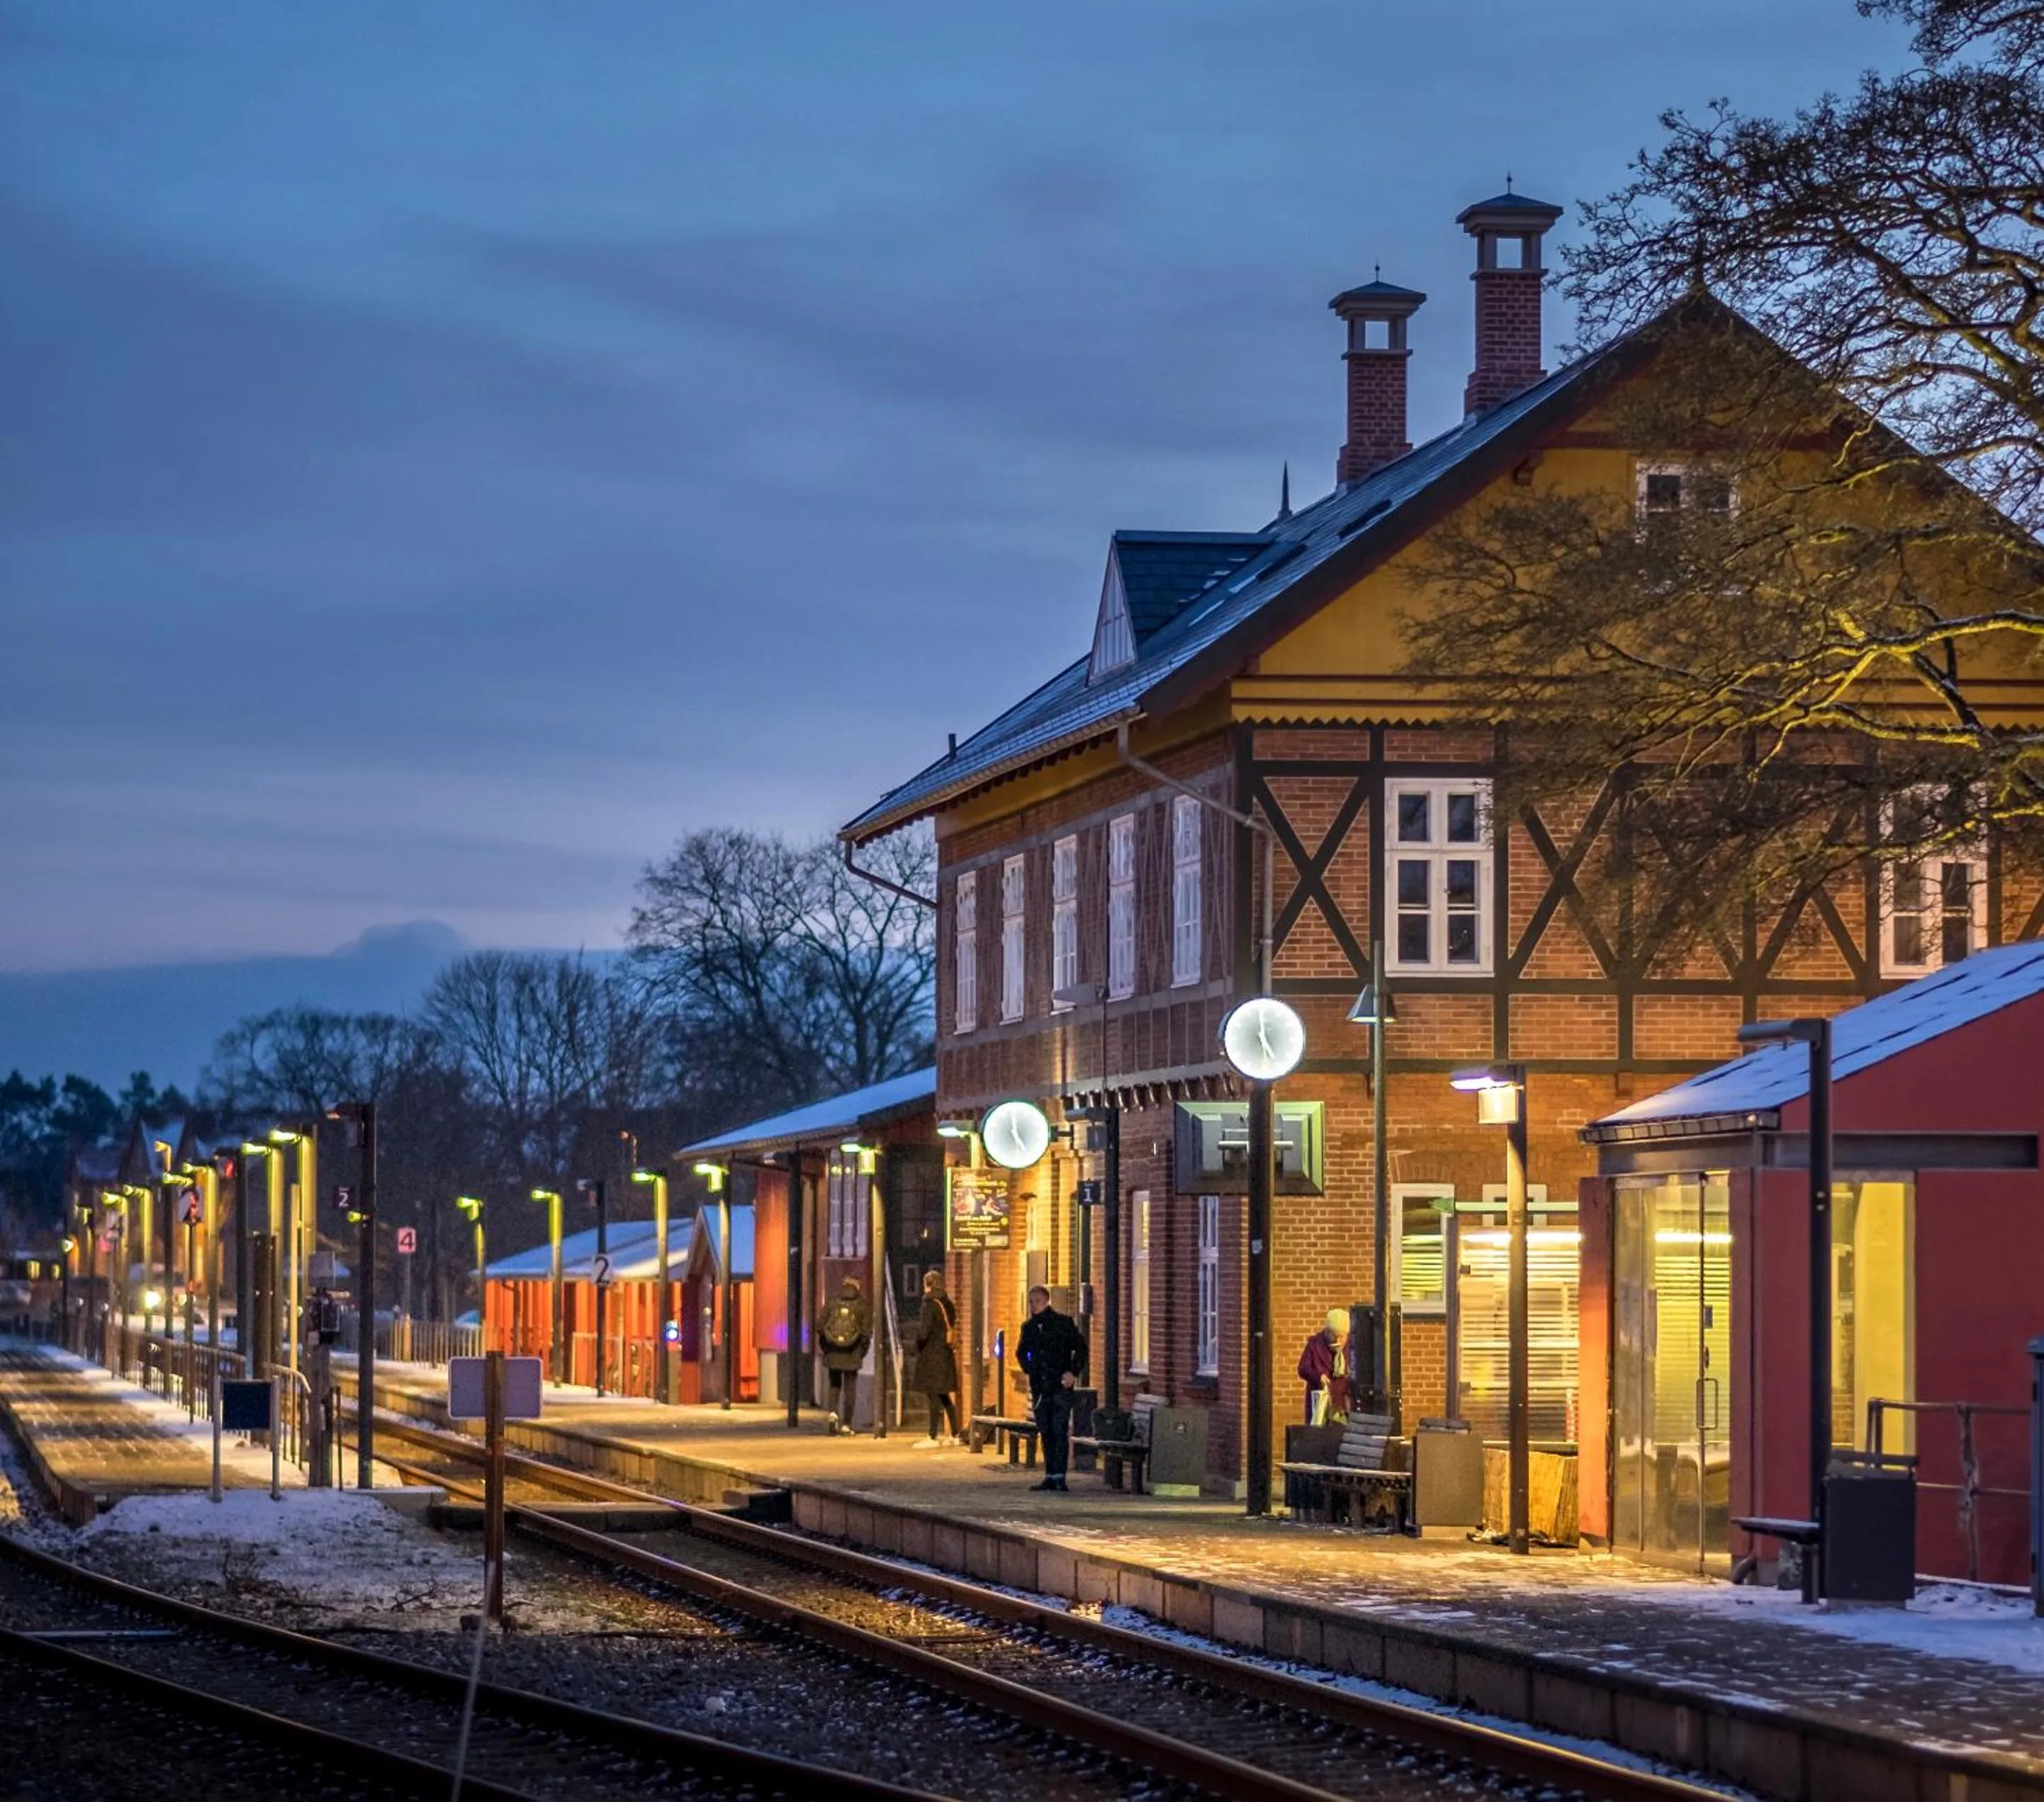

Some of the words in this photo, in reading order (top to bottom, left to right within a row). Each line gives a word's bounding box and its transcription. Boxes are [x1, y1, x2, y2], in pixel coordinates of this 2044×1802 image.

[338, 1192, 349, 1208] 2
[1083, 1188, 1093, 1202] 1
[400, 1232, 415, 1250] 4
[594, 1256, 610, 1284] 2
